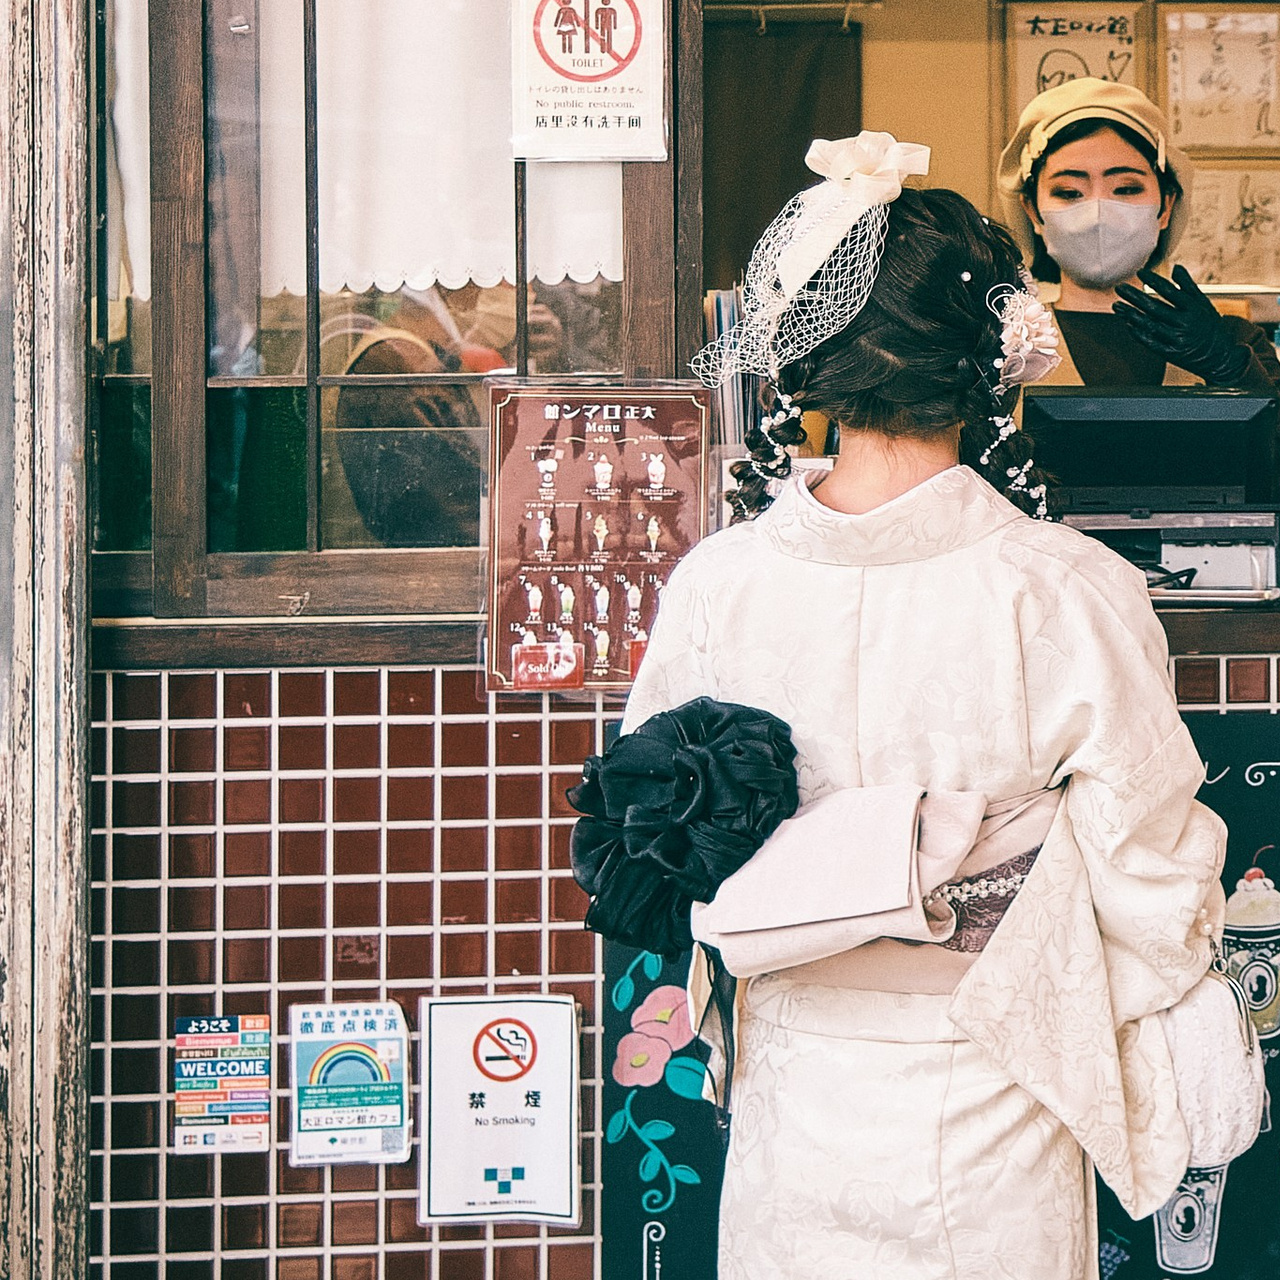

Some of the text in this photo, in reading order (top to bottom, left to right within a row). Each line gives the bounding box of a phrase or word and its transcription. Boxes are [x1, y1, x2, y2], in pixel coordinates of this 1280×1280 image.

[572, 58, 604, 68] TOILET
[535, 99, 635, 109] No public restroom.
[585, 421, 621, 433] Menu
[587, 452, 594, 461] 2
[640, 452, 647, 461] 3
[525, 510, 644, 520] 4 5 6
[519, 575, 526, 585] 7
[551, 576, 558, 585] 8
[616, 574, 626, 583] 10
[510, 623, 520, 632] 12
[547, 623, 557, 632] 13
[584, 623, 593, 631] 14
[187, 1019, 231, 1033] ようこそ
[300, 1018, 398, 1034] 徹底点検済
[181, 1061, 266, 1077] WELCOME
[475, 1115, 536, 1126] No Smoking
